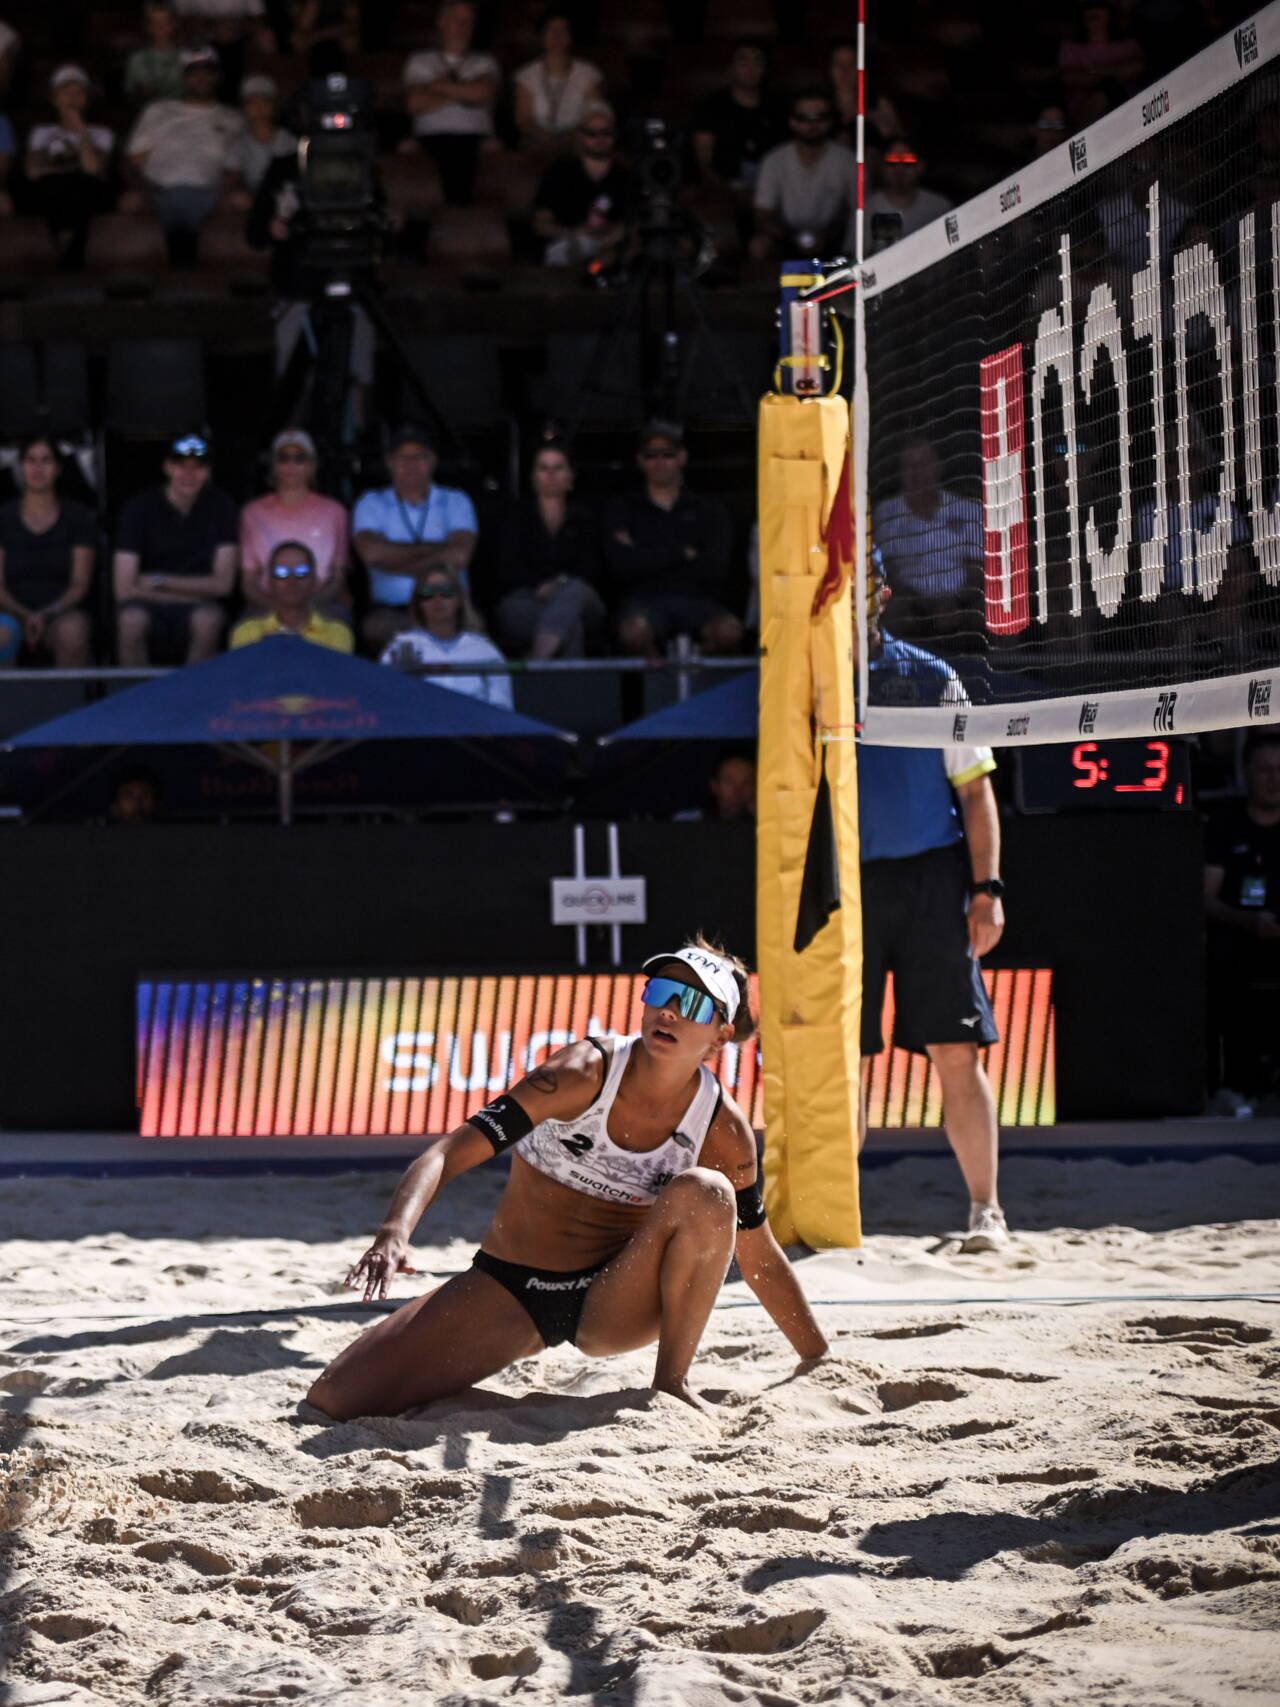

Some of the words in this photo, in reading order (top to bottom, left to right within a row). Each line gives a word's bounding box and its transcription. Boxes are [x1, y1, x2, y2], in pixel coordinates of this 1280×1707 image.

[1142, 88, 1165, 127] swatch
[559, 1133, 594, 1158] 2
[570, 1170, 632, 1201] swatch
[653, 1171, 674, 1188] SU
